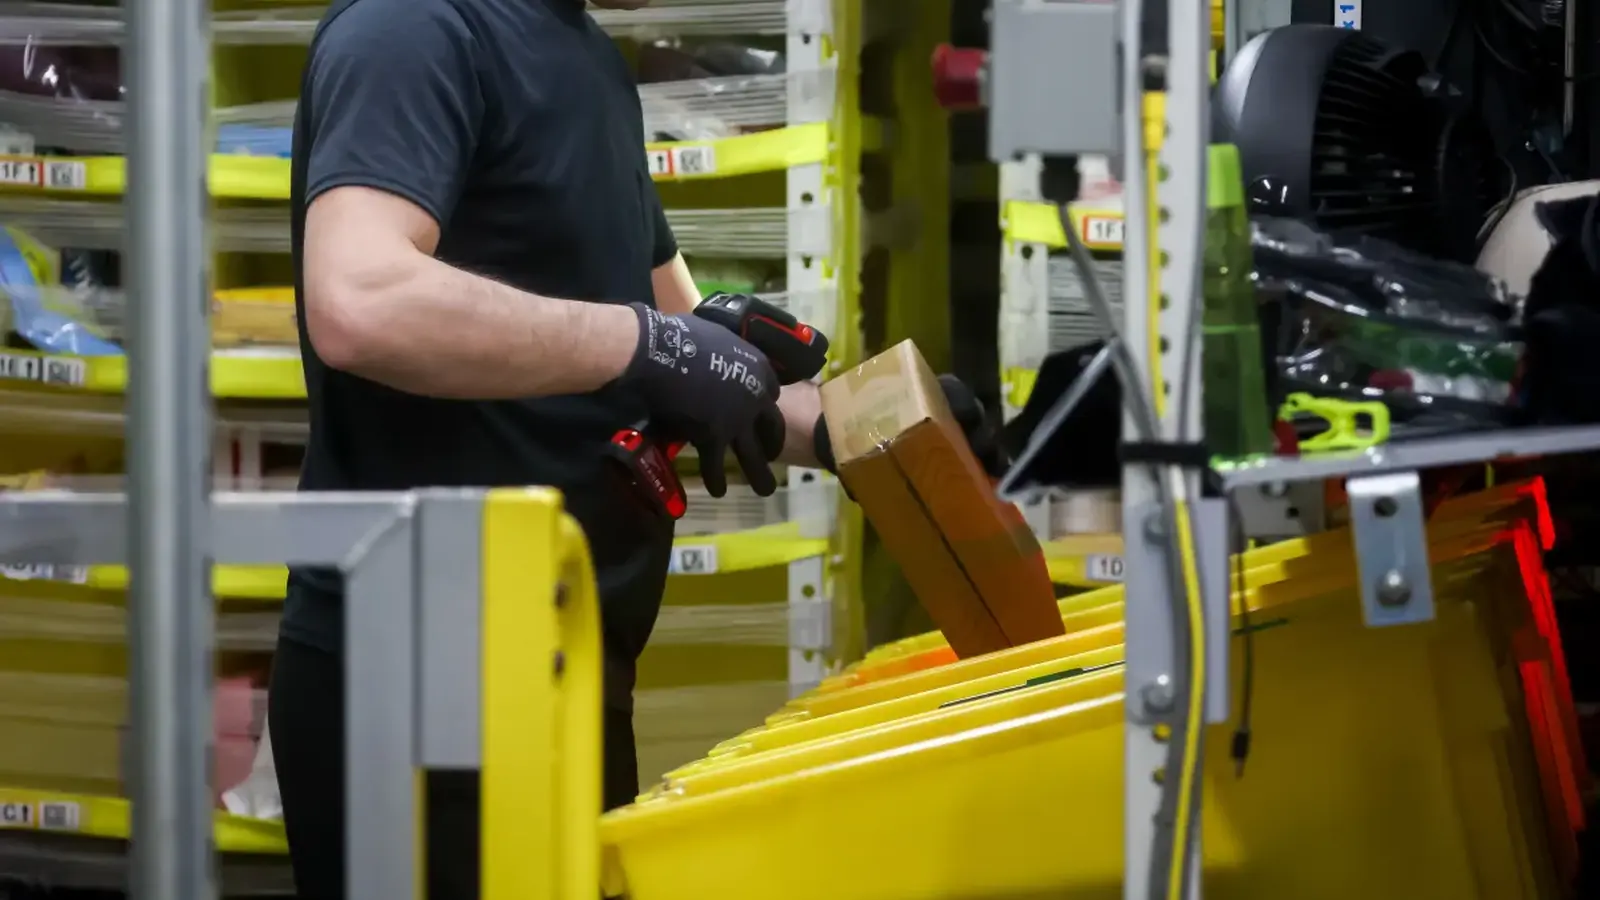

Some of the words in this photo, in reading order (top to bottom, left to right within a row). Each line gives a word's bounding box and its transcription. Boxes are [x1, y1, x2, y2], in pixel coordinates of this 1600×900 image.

[1095, 221, 1117, 240] 1F
[709, 352, 763, 397] HyFlex
[1100, 556, 1123, 577] 1D
